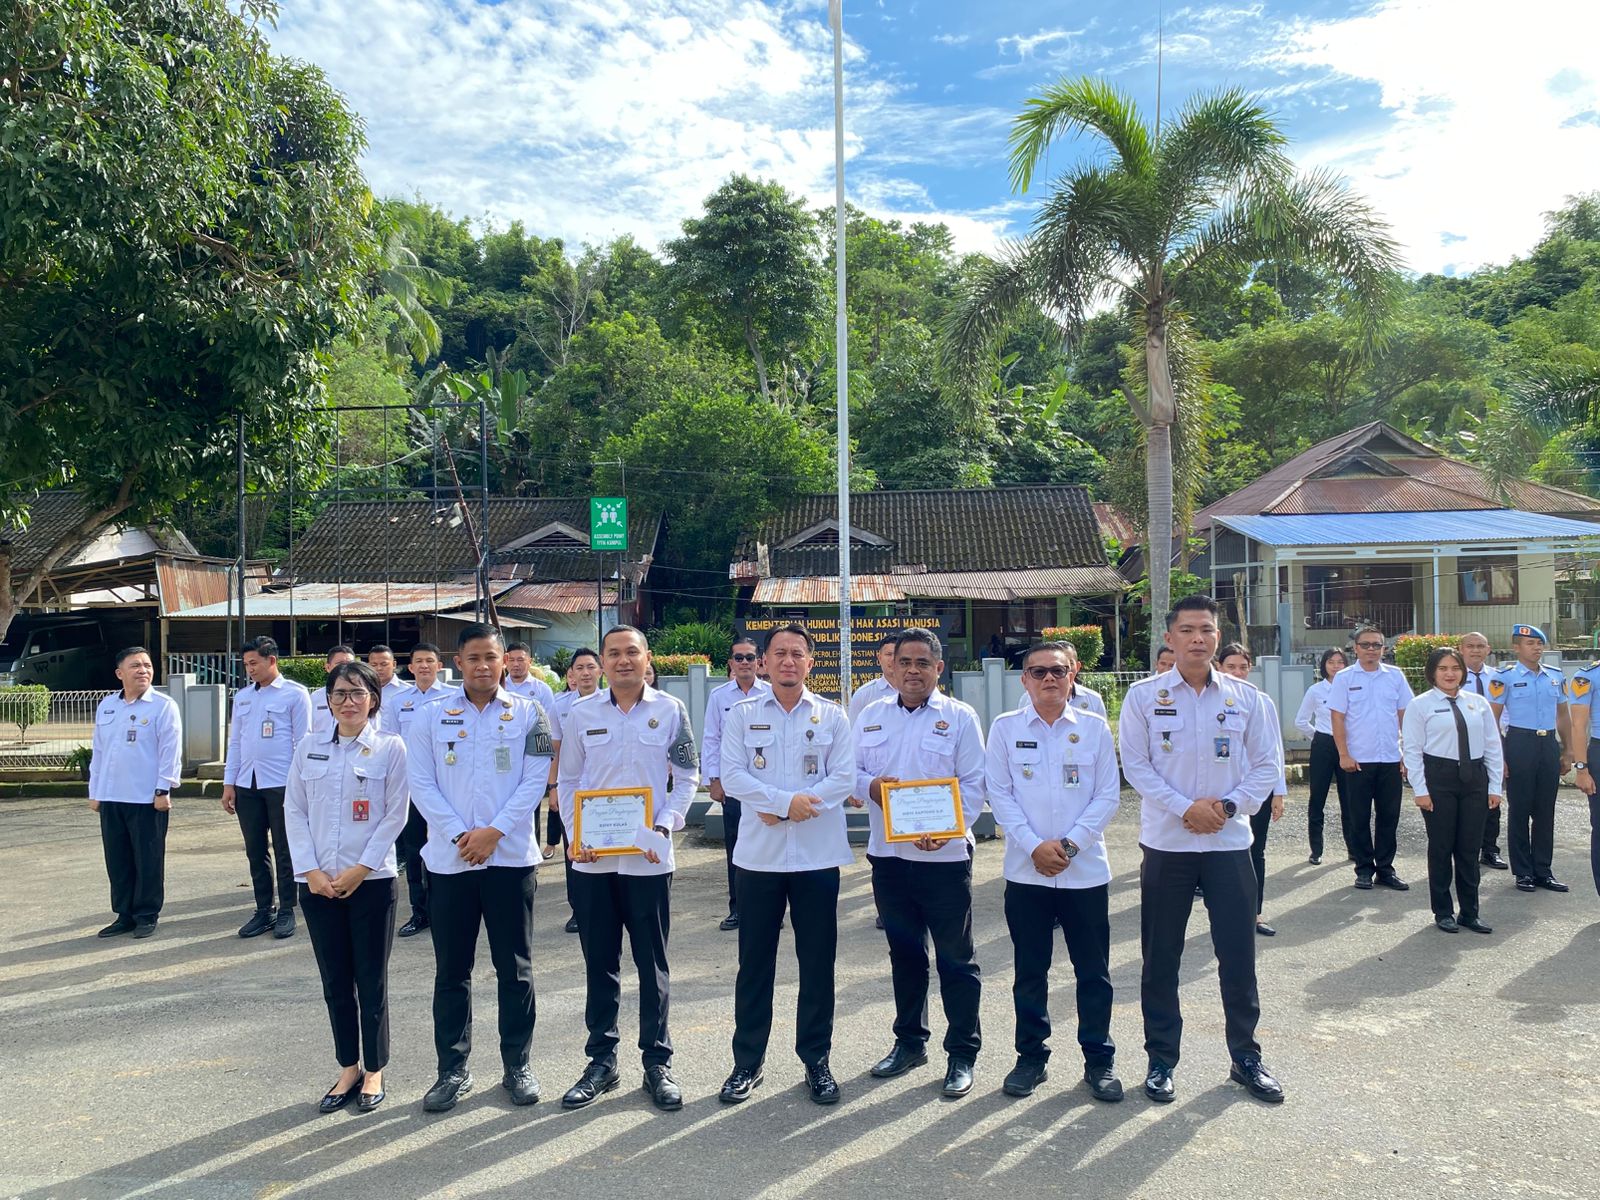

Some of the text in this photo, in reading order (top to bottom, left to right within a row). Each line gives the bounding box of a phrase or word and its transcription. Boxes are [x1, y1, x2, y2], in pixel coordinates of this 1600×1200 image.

[807, 619, 836, 629] HUKUM
[838, 618, 854, 629] DN
[857, 618, 874, 628] HAK
[877, 618, 900, 628] ASASI
[903, 618, 940, 628] MANUSIA
